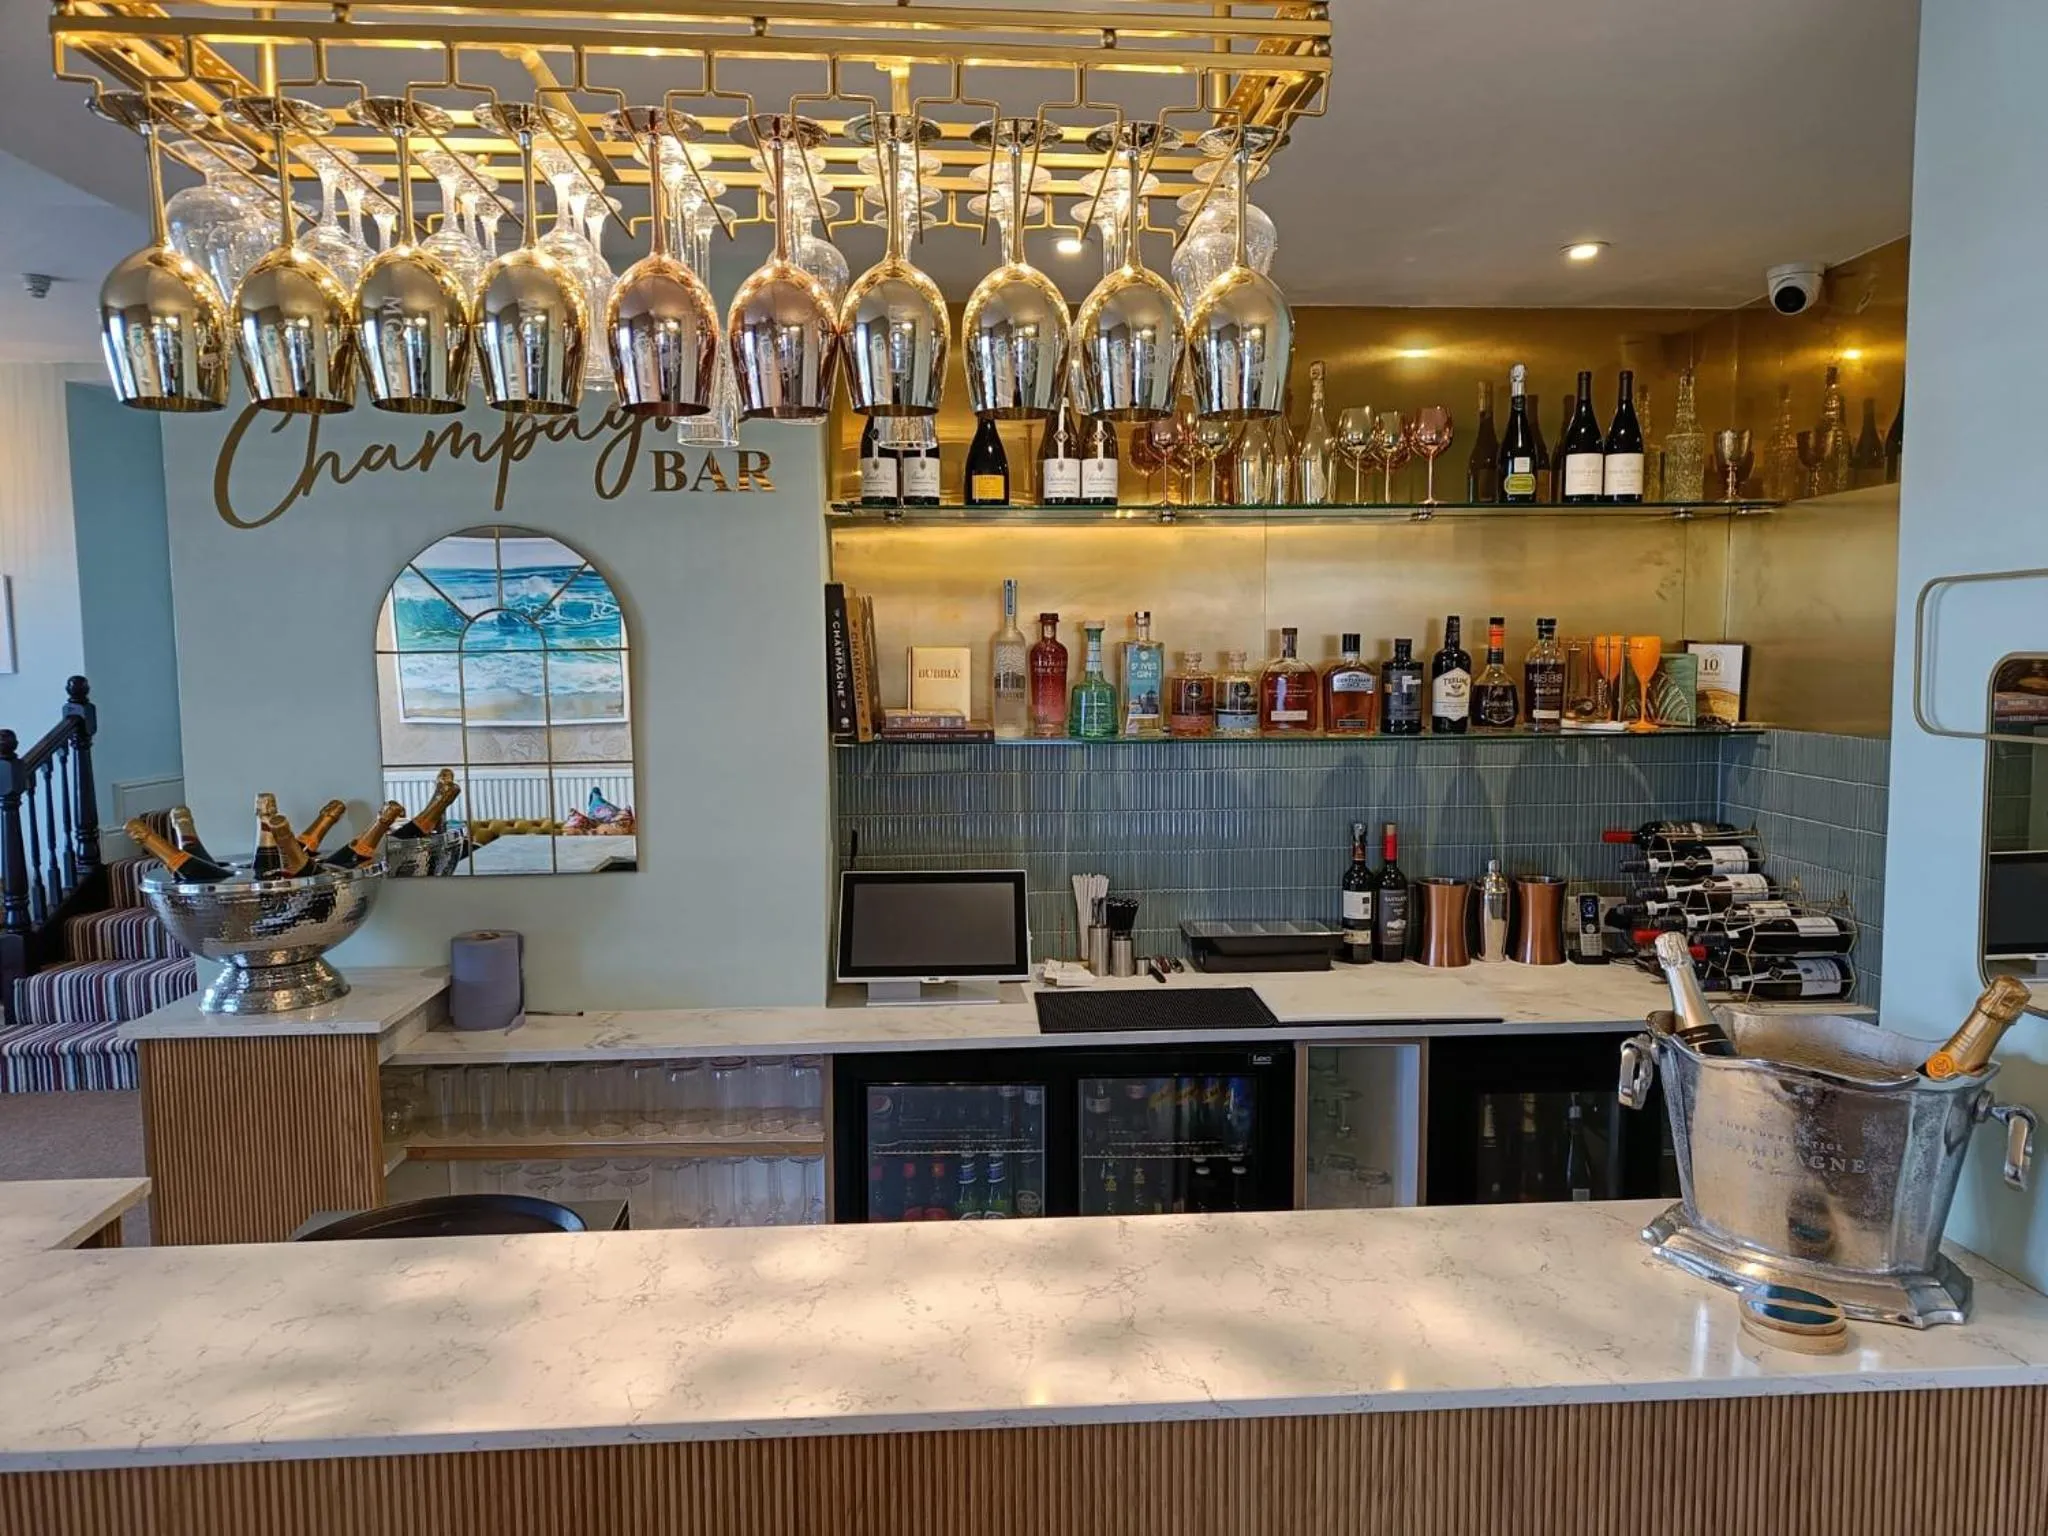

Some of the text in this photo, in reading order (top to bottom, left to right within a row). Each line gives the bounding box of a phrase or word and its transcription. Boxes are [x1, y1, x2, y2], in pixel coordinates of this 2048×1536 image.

[213, 402, 752, 529] Champag
[649, 449, 777, 493] BAR
[831, 620, 846, 698] CHAMPAGNE
[850, 631, 864, 707] CHAMPAGNE
[918, 668, 961, 679] BUBBLY
[1703, 658, 1720, 672] 10
